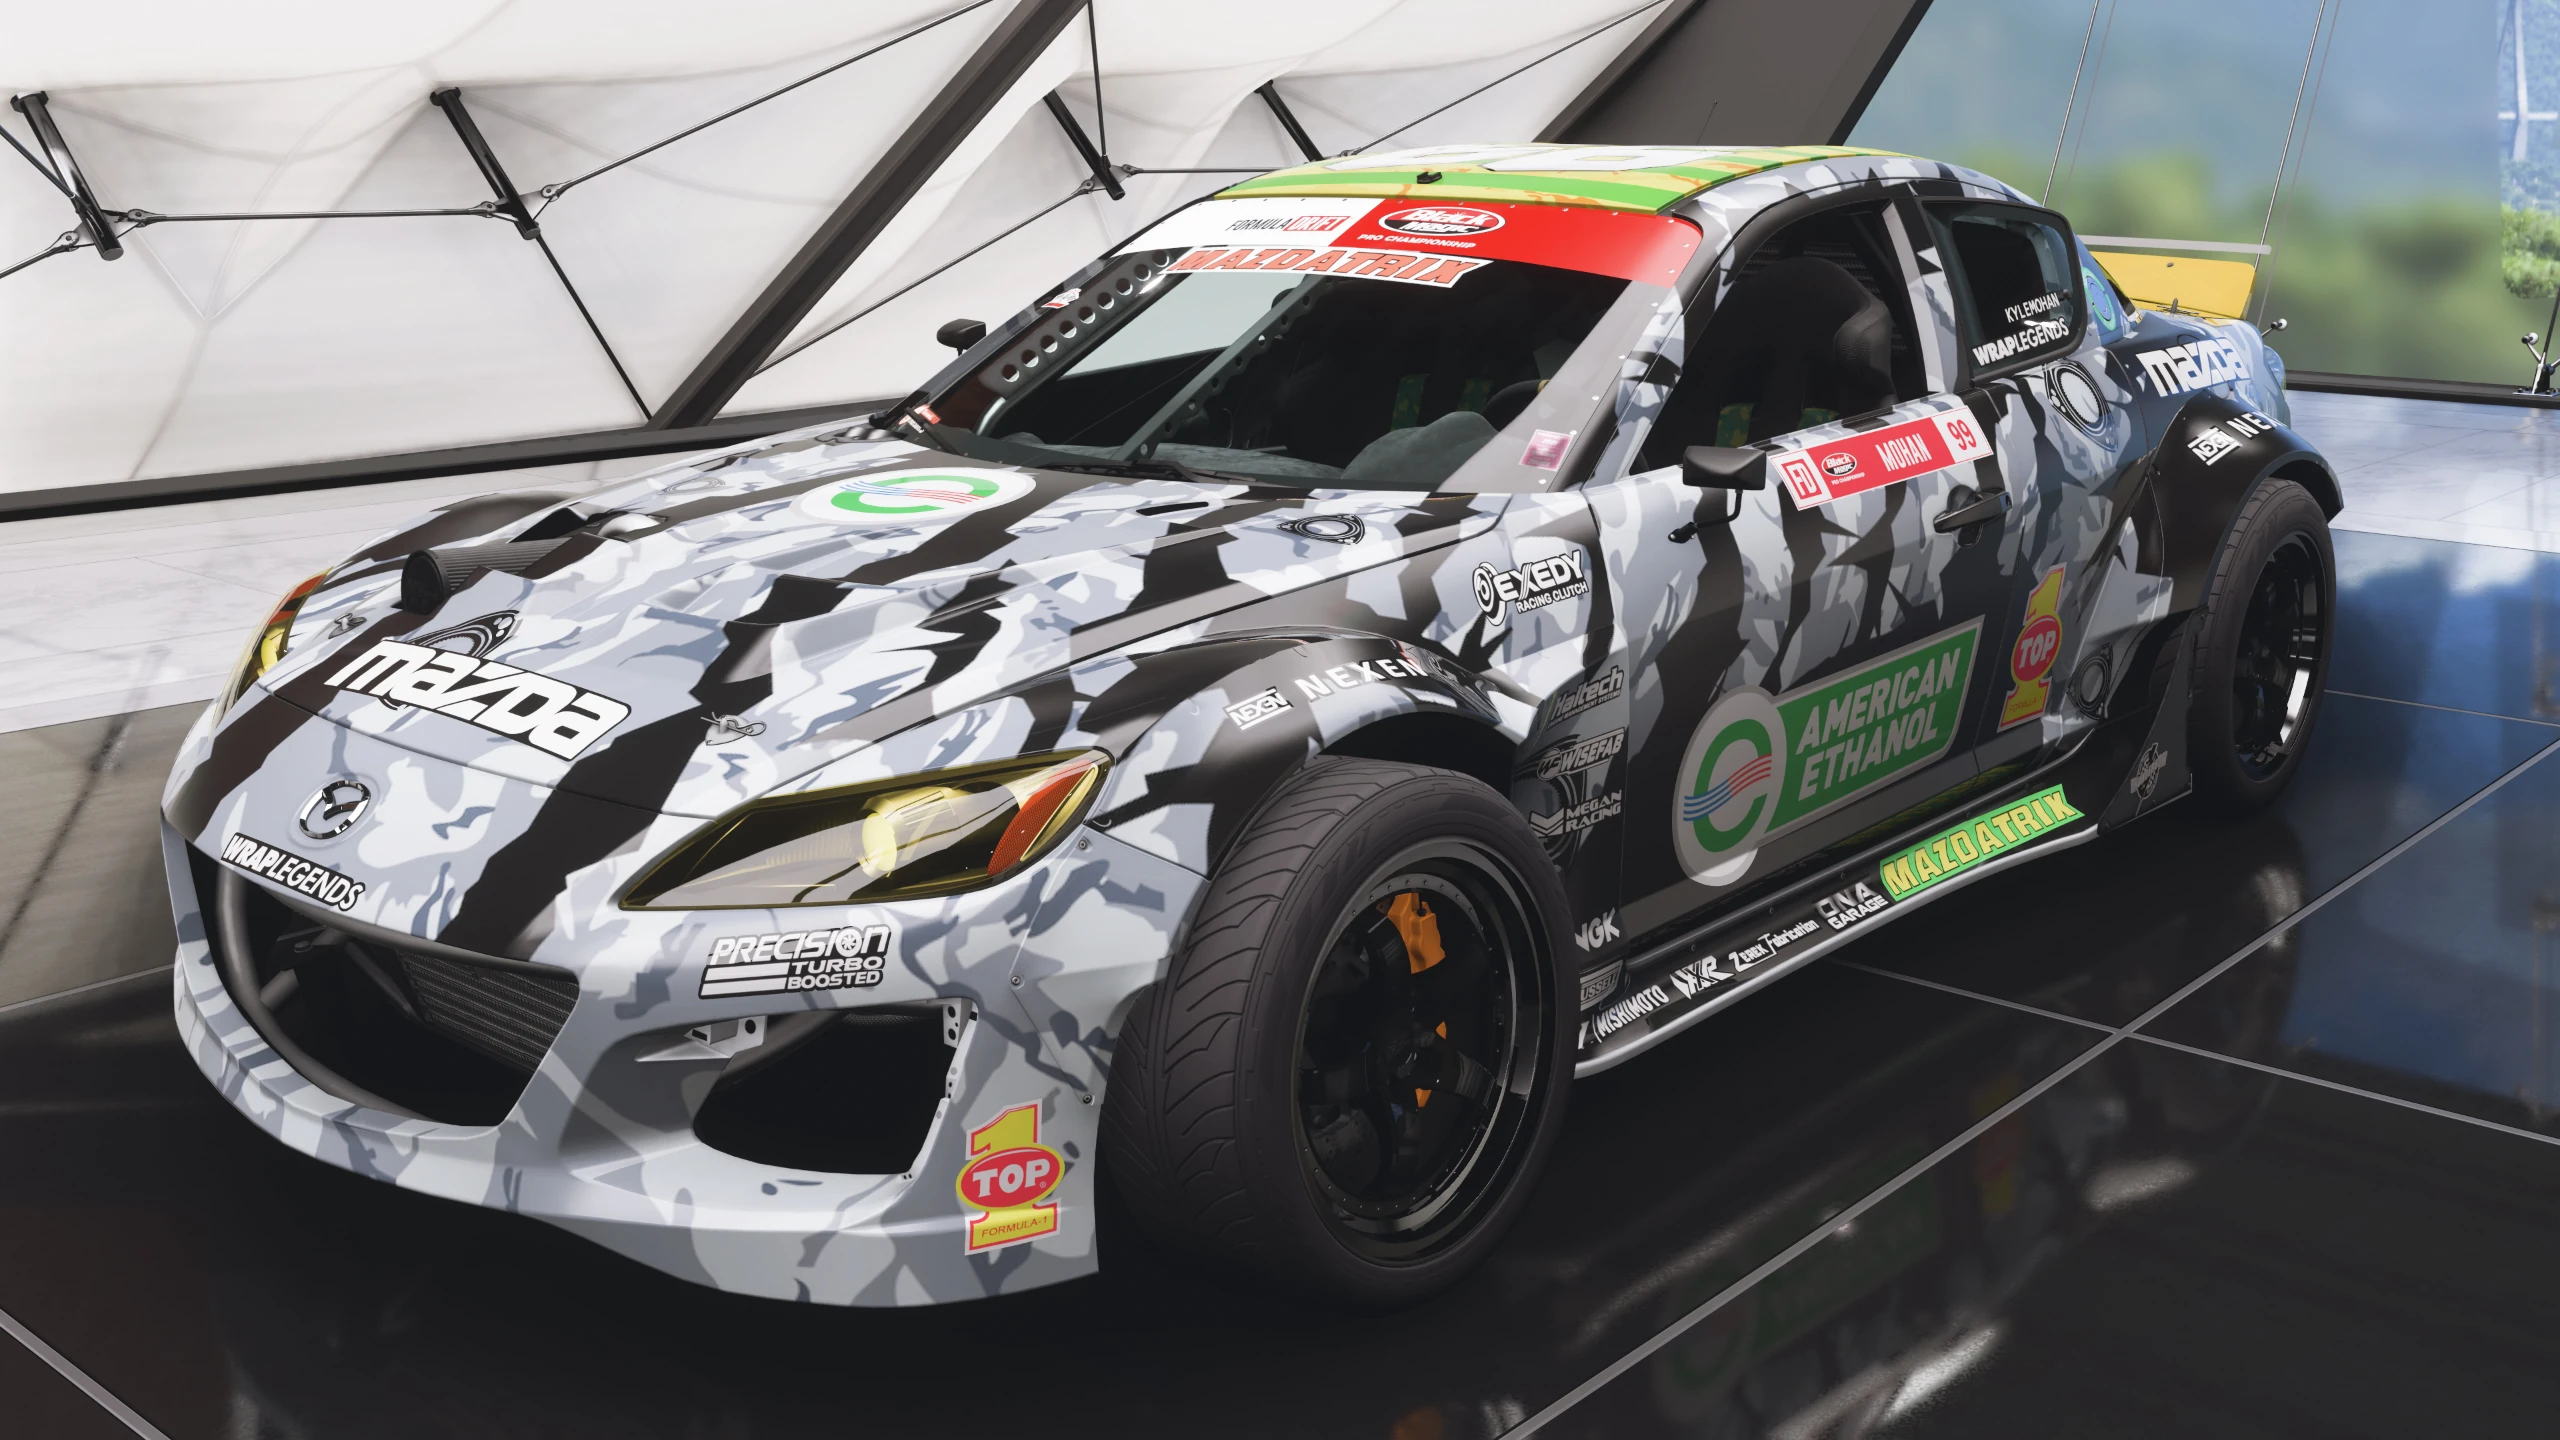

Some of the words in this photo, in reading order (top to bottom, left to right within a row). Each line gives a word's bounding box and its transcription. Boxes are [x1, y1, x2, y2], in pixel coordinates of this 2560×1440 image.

[1225, 218, 1293, 231] FORMULA
[1284, 215, 1351, 231] DRIFT
[1399, 221, 1479, 233] Magic
[1401, 209, 1493, 226] Black
[1357, 233, 1384, 241] PRO
[1384, 235, 1477, 249] CHAMPIONSHIP
[1166, 248, 1478, 285] MAZDATRIX
[1972, 318, 2069, 366] WRAPLEGENDS
[1875, 433, 1933, 472] MOHAN
[1947, 419, 1977, 451] 99
[1826, 454, 1851, 468] Black
[1786, 462, 1818, 497] FD
[1493, 550, 1583, 601] EXEDY
[1516, 592, 1553, 613] RACING
[1552, 581, 1588, 602] CLUTCH
[2019, 630, 2057, 669] TOP
[1294, 658, 1429, 701] NEXEN
[1551, 667, 1623, 720] Haltech
[1796, 647, 1961, 755] AMERICAN
[1561, 734, 1625, 772] WISEFAB
[1798, 701, 1938, 801] ETHANOL
[1565, 802, 1621, 832] RACING
[1566, 790, 1622, 819] MEGAN
[1882, 790, 2077, 896] MAZDATRIX
[223, 835, 364, 910] WRAPLEGENDS
[1827, 895, 1889, 930] GARAGE
[709, 925, 890, 966] PRECISION
[787, 971, 880, 990] BOOSTED
[791, 956, 883, 975] TURBO
[1581, 972, 1618, 1001] USSELL
[1596, 984, 1669, 1038] MISHIMOTO
[972, 1158, 1051, 1198] TOP
[981, 1215, 1048, 1238] FORMULA-1
